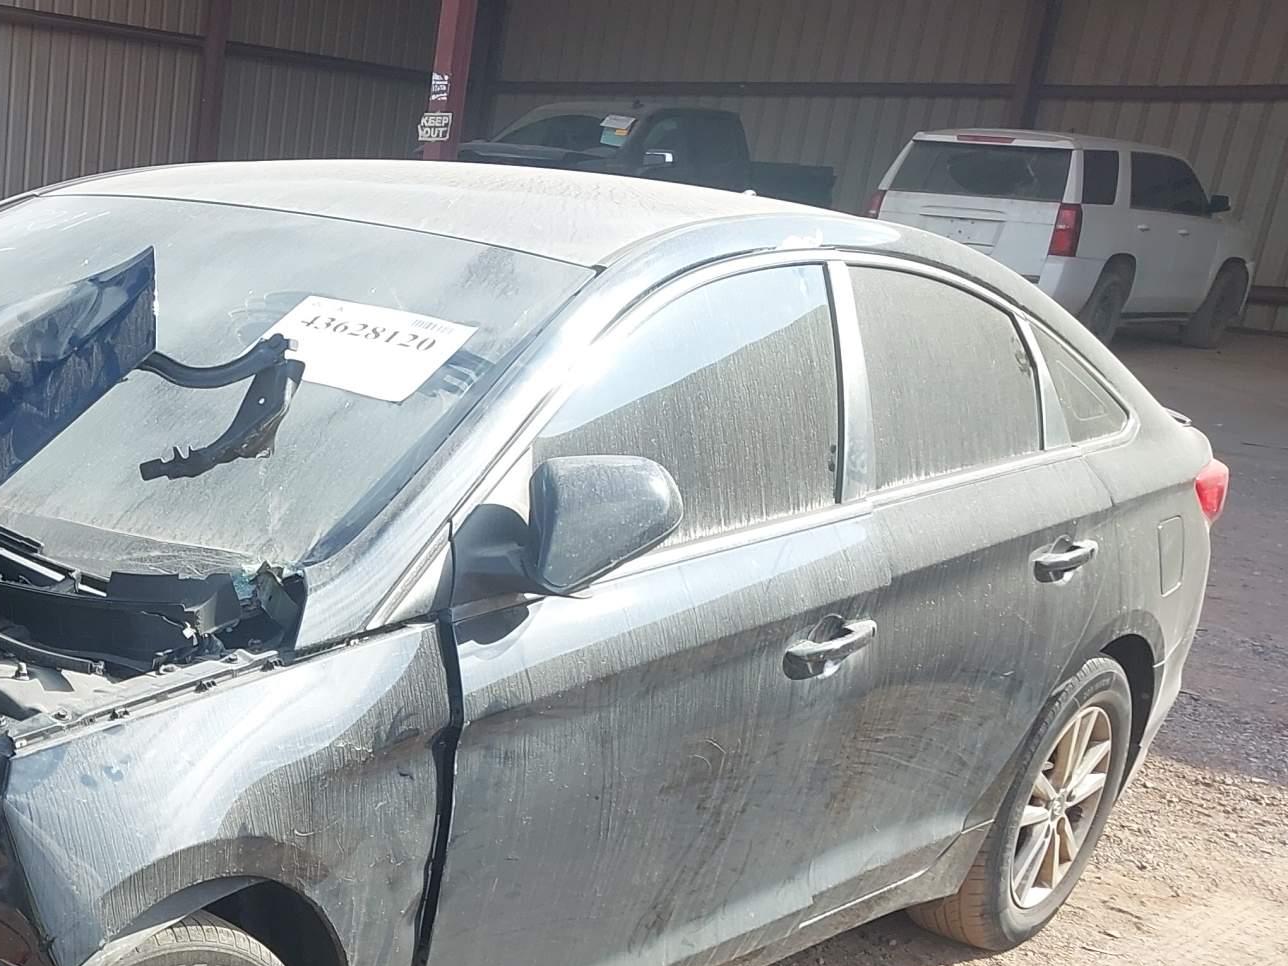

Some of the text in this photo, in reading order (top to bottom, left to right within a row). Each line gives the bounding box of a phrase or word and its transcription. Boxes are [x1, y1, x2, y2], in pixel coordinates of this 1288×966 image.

[420, 116, 449, 127] KEEP
[423, 127, 447, 137] OUT
[300, 315, 437, 351] 43628120
